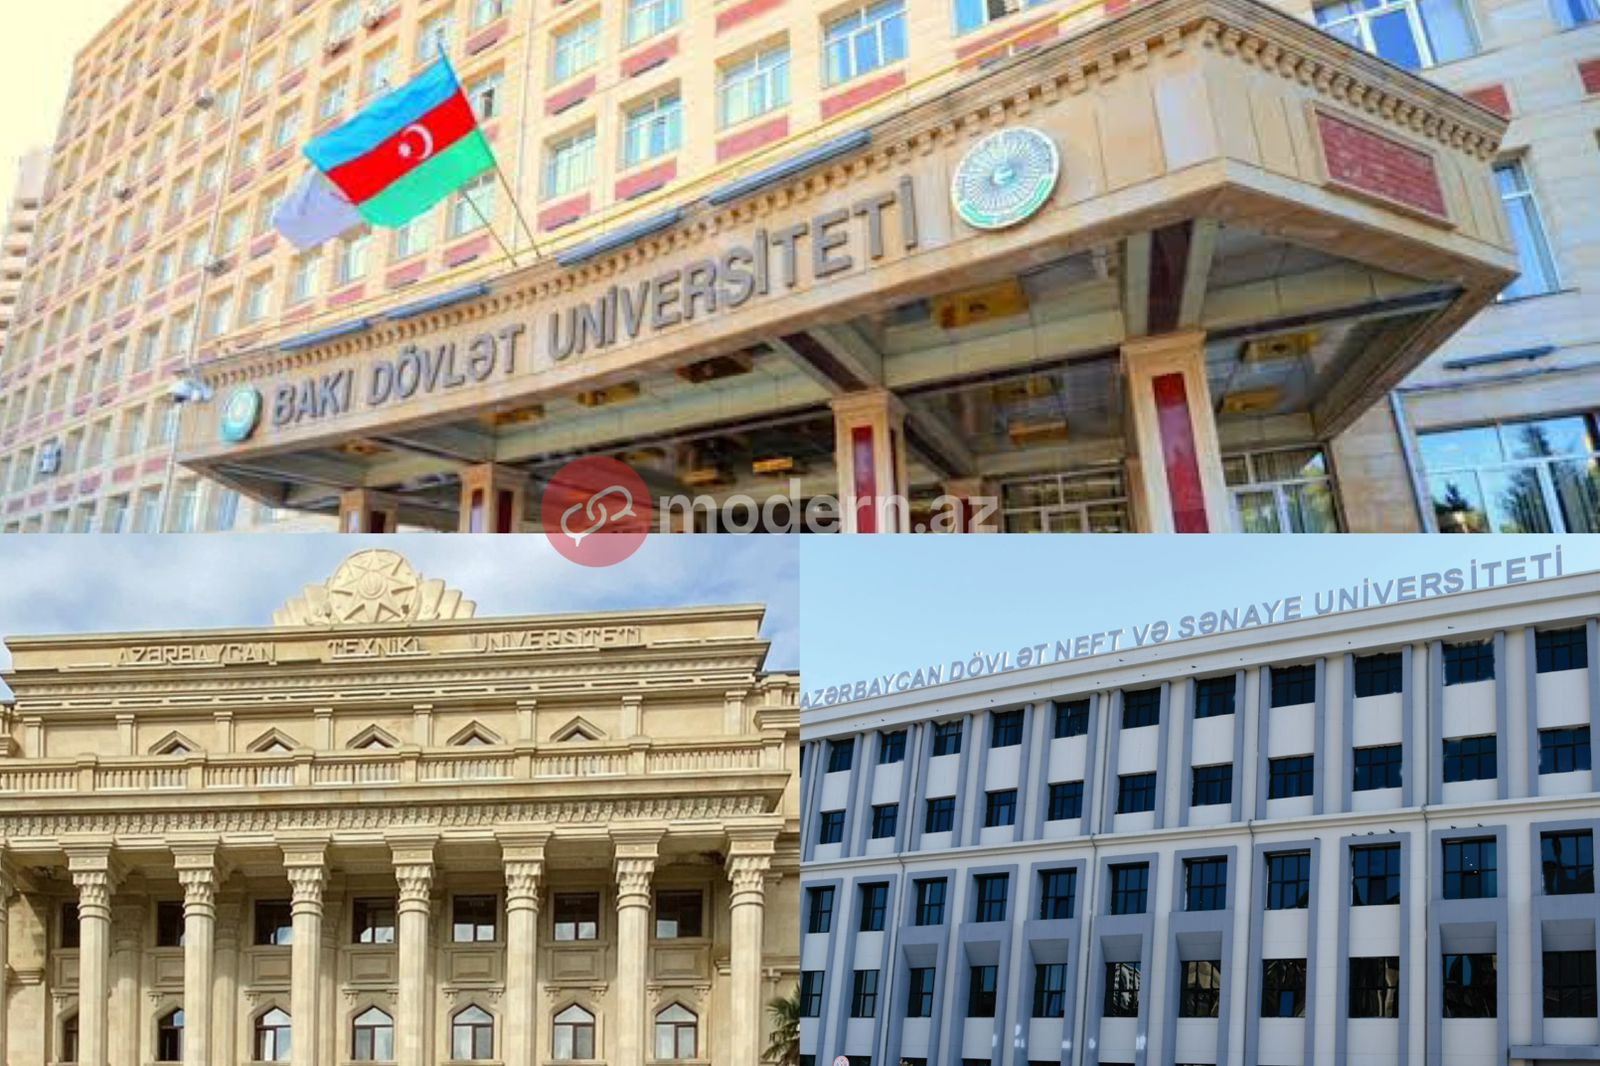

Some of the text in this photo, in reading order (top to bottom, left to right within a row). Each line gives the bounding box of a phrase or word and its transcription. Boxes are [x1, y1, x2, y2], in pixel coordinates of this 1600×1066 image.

[273, 369, 355, 426] BAKI
[366, 323, 527, 406] DÖVLƏT
[117, 642, 277, 667] AZƏRBAYCAN
[800, 544, 1563, 710] AZƏRBAYCAN DÖVLƏT NEFT VƏ SƏNAYE UNİVERSİTETİ
